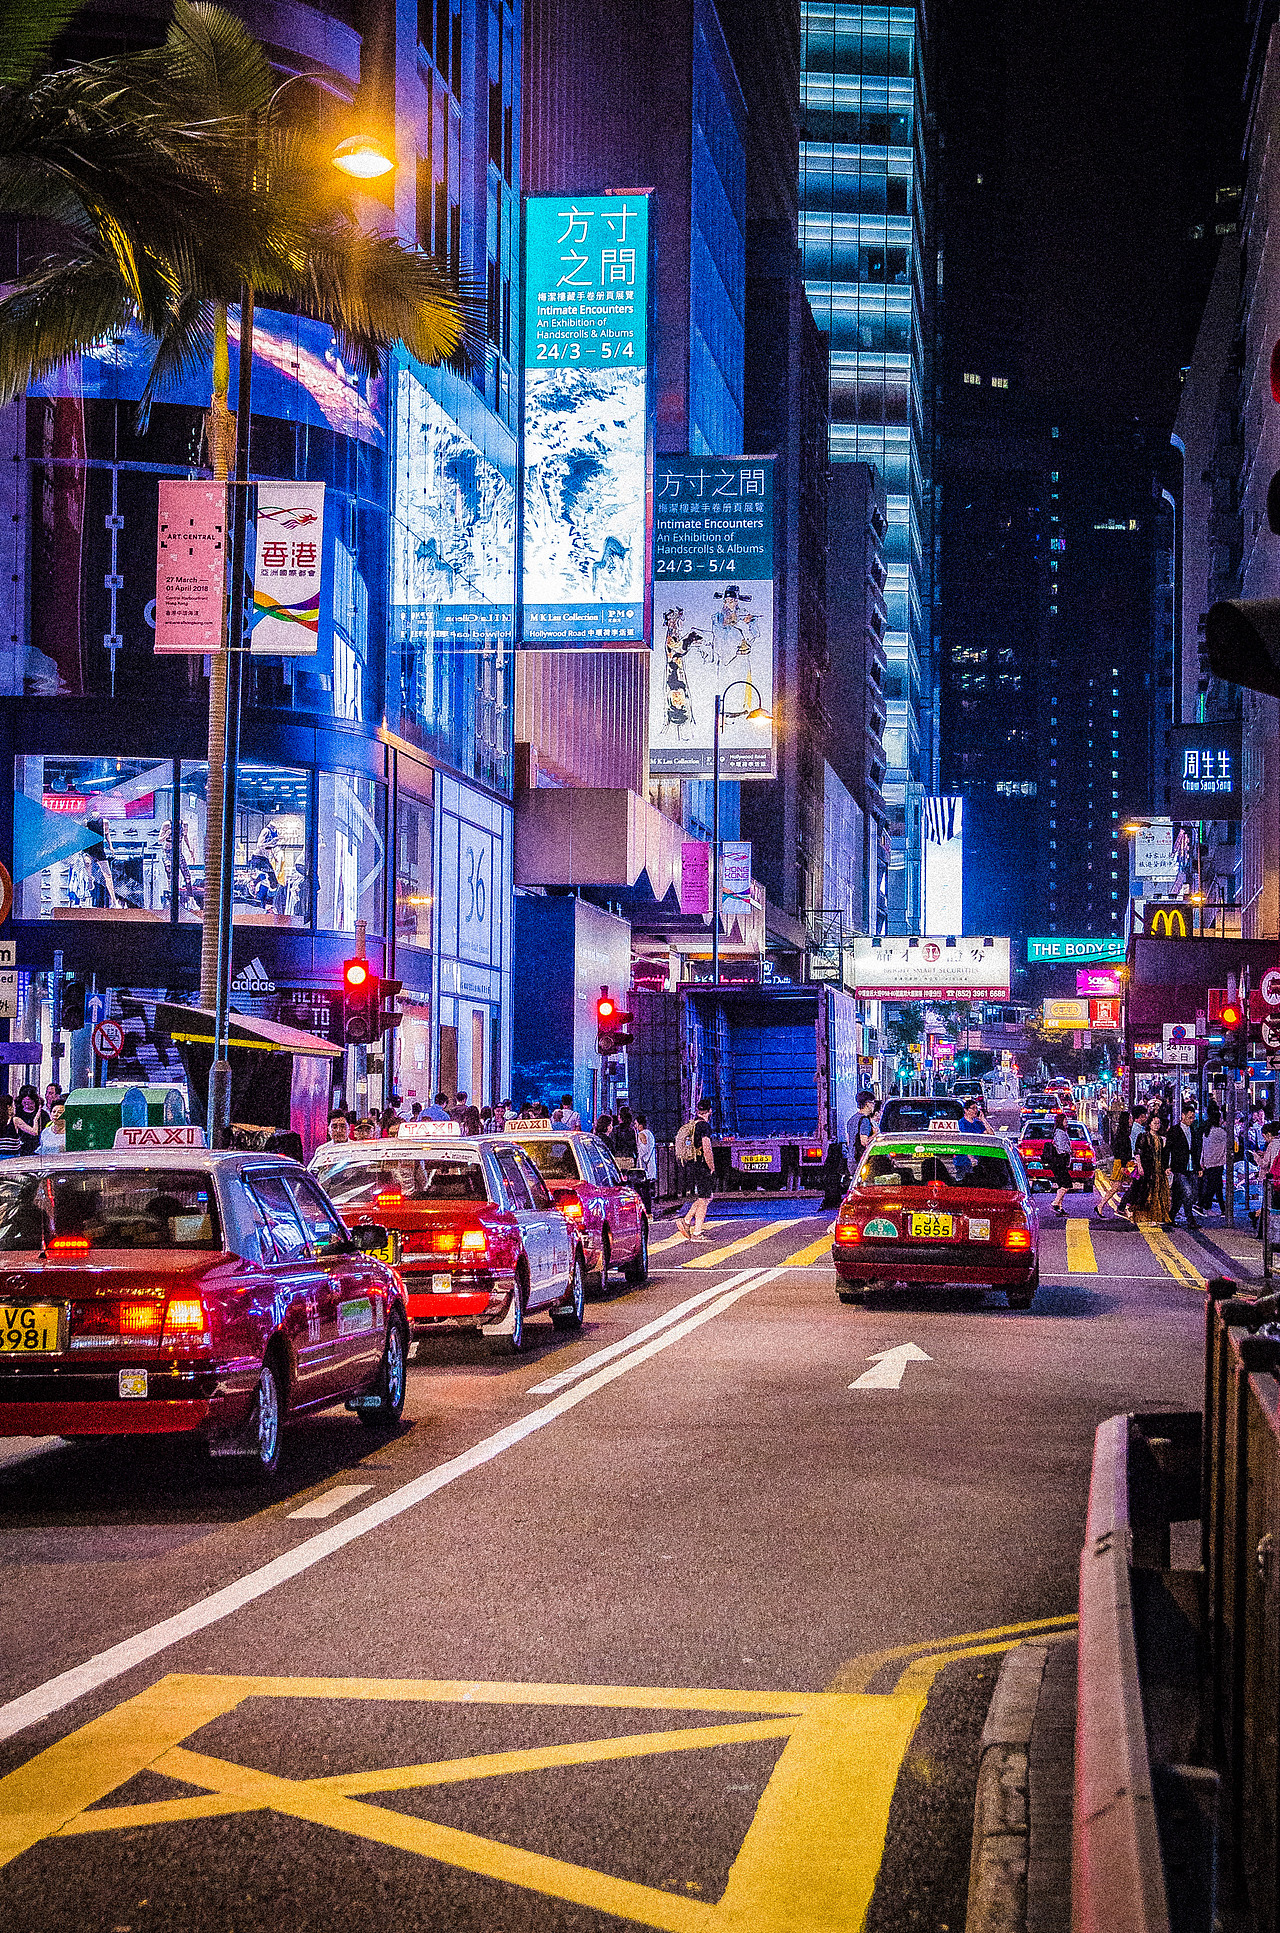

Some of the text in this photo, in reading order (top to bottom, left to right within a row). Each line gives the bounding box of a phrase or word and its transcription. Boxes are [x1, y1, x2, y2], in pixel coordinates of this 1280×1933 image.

[557, 203, 638, 243] 方寸
[556, 248, 636, 287] 之間
[537, 304, 634, 315] Intimate Encounters
[537, 317, 608, 328] An Exhibition of
[536, 328, 634, 339] Handscrolls & Albums
[536, 343, 581, 360] 24/3
[601, 341, 635, 359] 5/4
[658, 468, 765, 497] 方寸之間
[657, 519, 764, 529] Intimate Encounters
[183, 533, 216, 541] CENTRAL
[656, 532, 735, 542] An Exhibition of
[261, 541, 317, 568] 香港
[656, 544, 764, 554] Handscrolls & Albums
[656, 559, 693, 573] 24/3
[708, 559, 736, 572] 5/4
[175, 585, 192, 593] April
[530, 613, 539, 622] M
[540, 613, 547, 622] K
[562, 612, 599, 621] Collection
[529, 629, 587, 638] Hollywood Road
[1182, 749, 1231, 779] 周生生
[1200, 779, 1216, 793] Sang
[1216, 779, 1232, 793] Sang
[1032, 943, 1061, 956] THE
[1065, 943, 1105, 956] BODY
[231, 978, 276, 992] adidas
[311, 1007, 330, 1026] TO
[1166, 1044, 1192, 1052] 24 hrs
[1168, 1052, 1189, 1062] 全日
[405, 1122, 453, 1135] TAXI
[508, 1120, 549, 1132] TAXI
[931, 1121, 957, 1130] TAXI
[123, 1128, 195, 1145] TAXI
[924, 1215, 940, 1225] JX
[914, 1225, 950, 1236] 5955
[5, 1308, 36, 1329] VG
